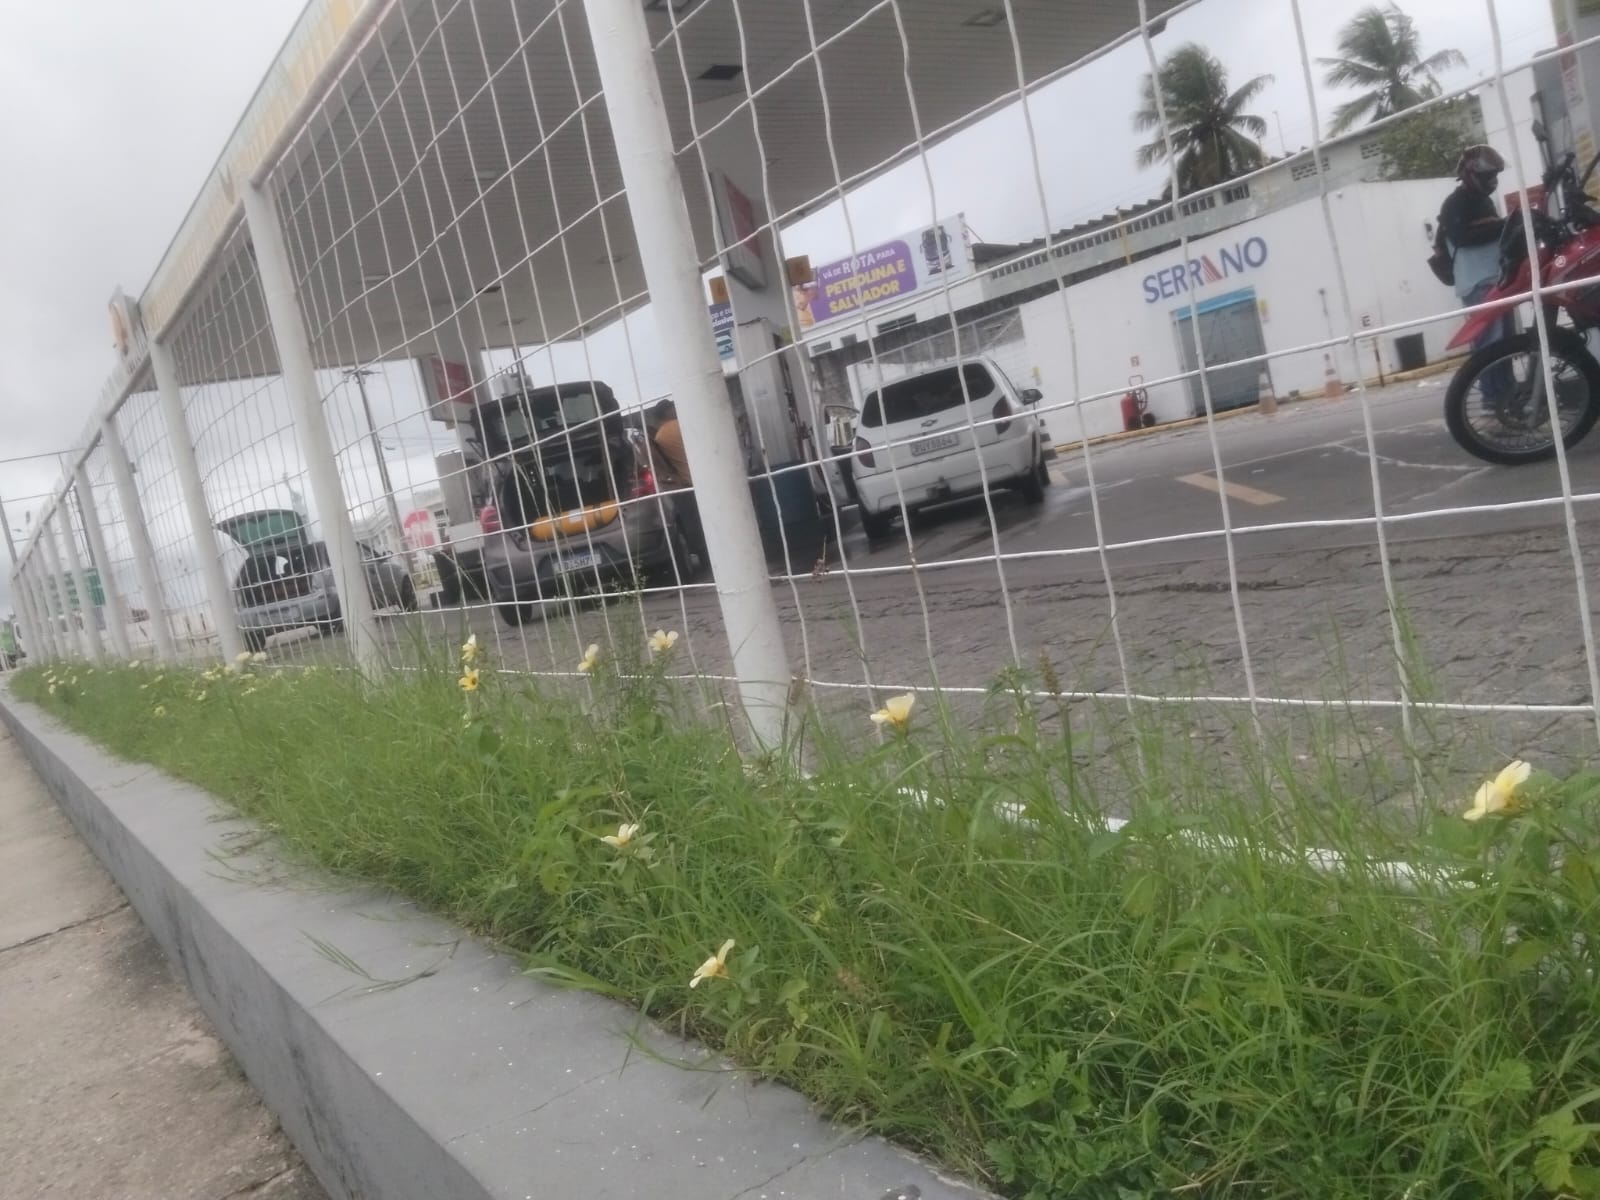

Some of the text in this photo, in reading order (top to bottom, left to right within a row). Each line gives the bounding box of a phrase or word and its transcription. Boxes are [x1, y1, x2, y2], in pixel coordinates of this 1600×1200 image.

[825, 263, 897, 297] PETROLINA
[896, 258, 906, 273] E
[842, 253, 876, 274] ROTA
[876, 248, 896, 261] PARA
[1142, 236, 1268, 304] SERRANO
[829, 279, 900, 314] SALVADOR
